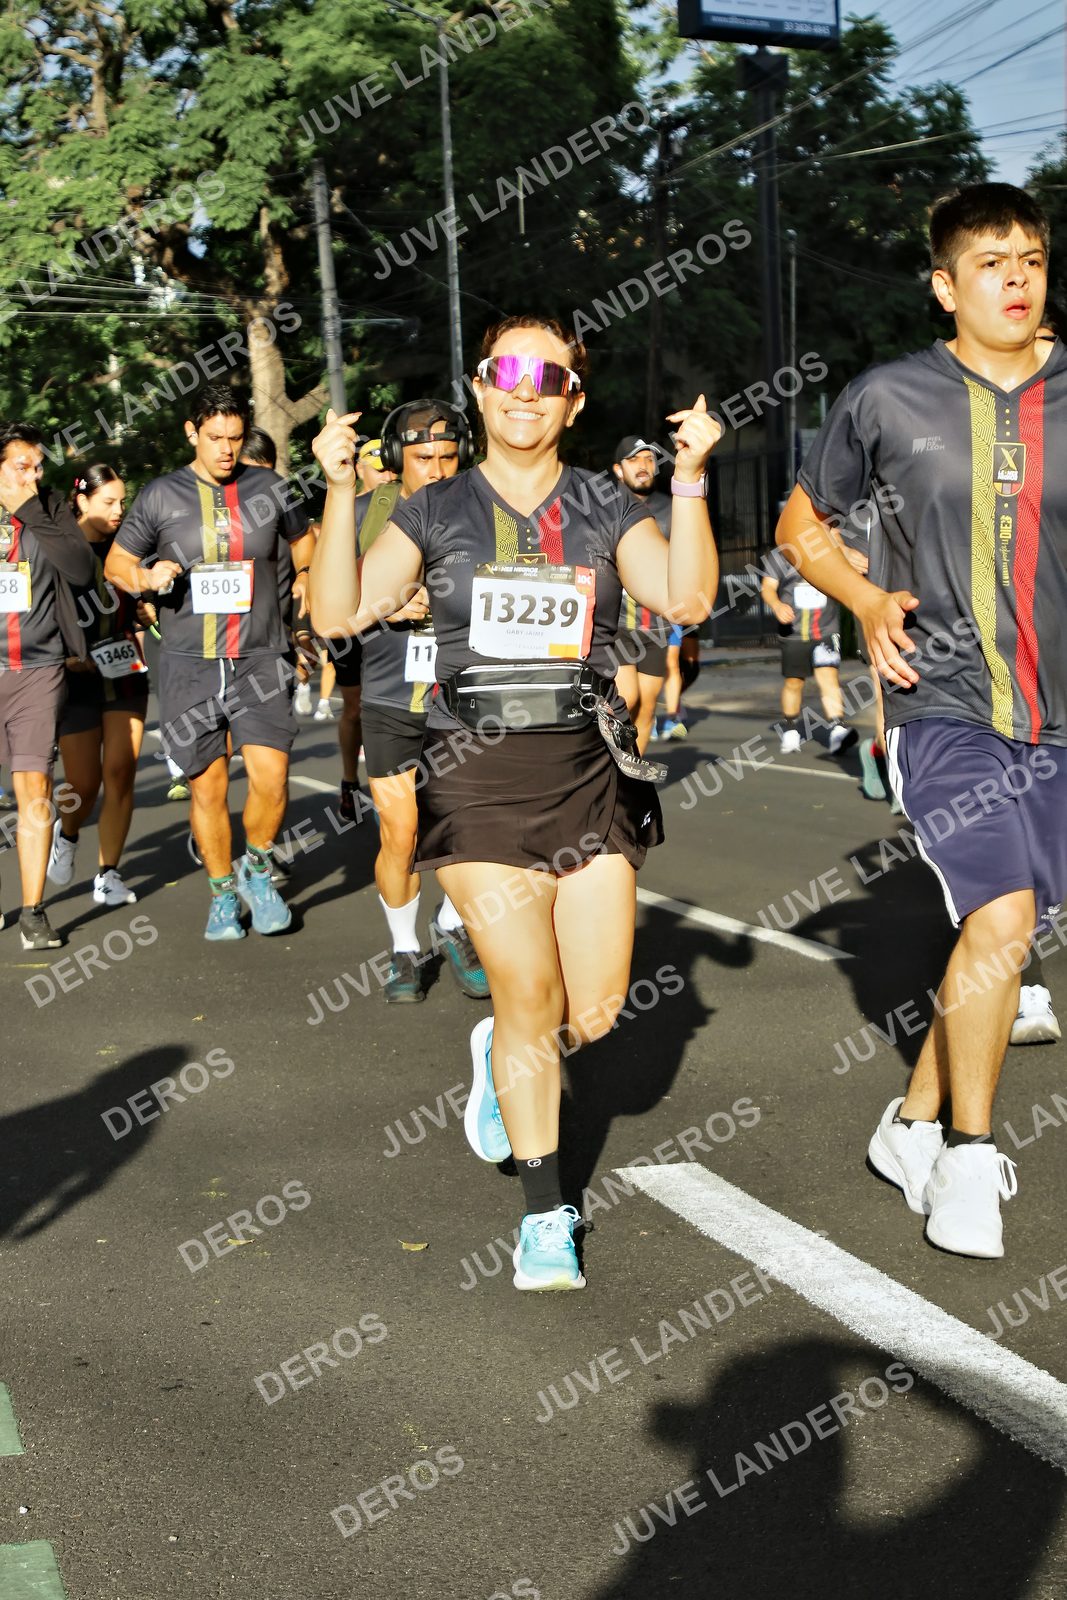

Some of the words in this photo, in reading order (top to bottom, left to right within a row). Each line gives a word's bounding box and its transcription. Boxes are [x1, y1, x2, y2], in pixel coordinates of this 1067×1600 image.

[201, 578, 241, 595] 8505
[479, 591, 579, 628] 13239
[96, 644, 135, 666] 13465
